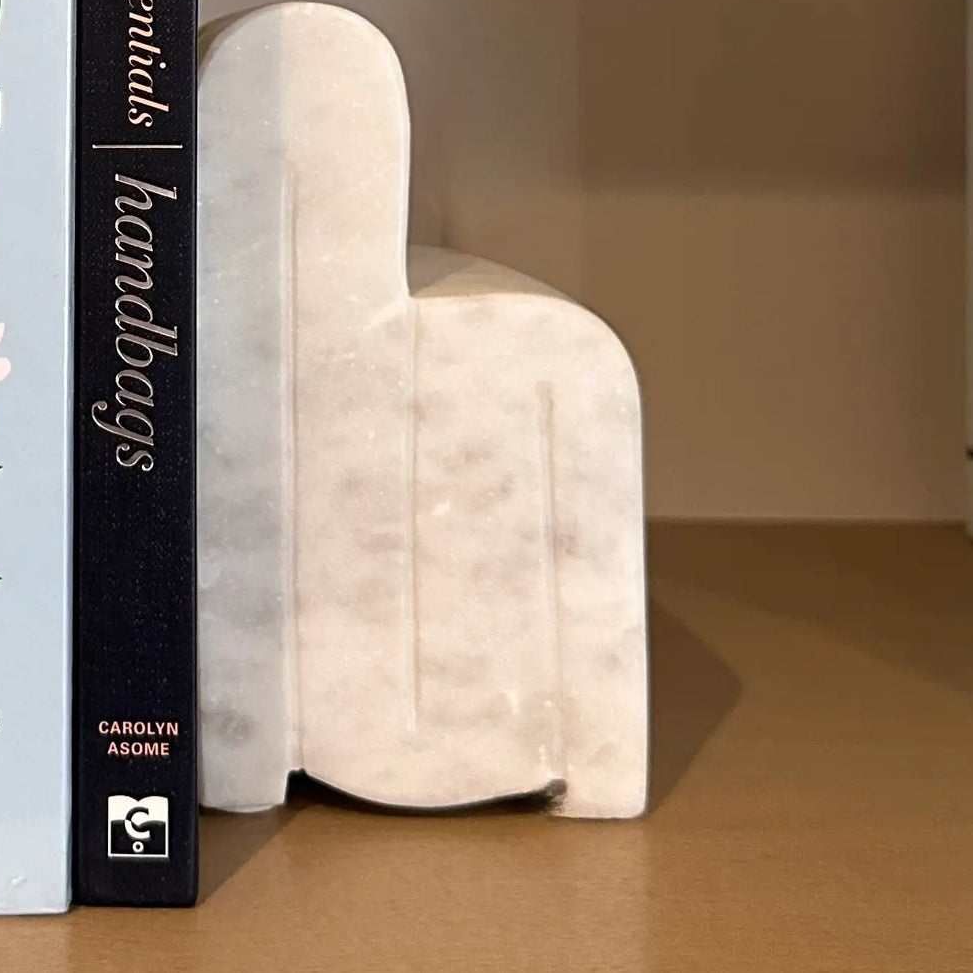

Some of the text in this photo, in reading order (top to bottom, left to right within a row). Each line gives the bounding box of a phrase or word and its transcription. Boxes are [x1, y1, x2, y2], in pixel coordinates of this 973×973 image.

[92, 174, 178, 472] handbags
[98, 720, 179, 737] CAROLYN
[107, 741, 170, 756] ASOME
